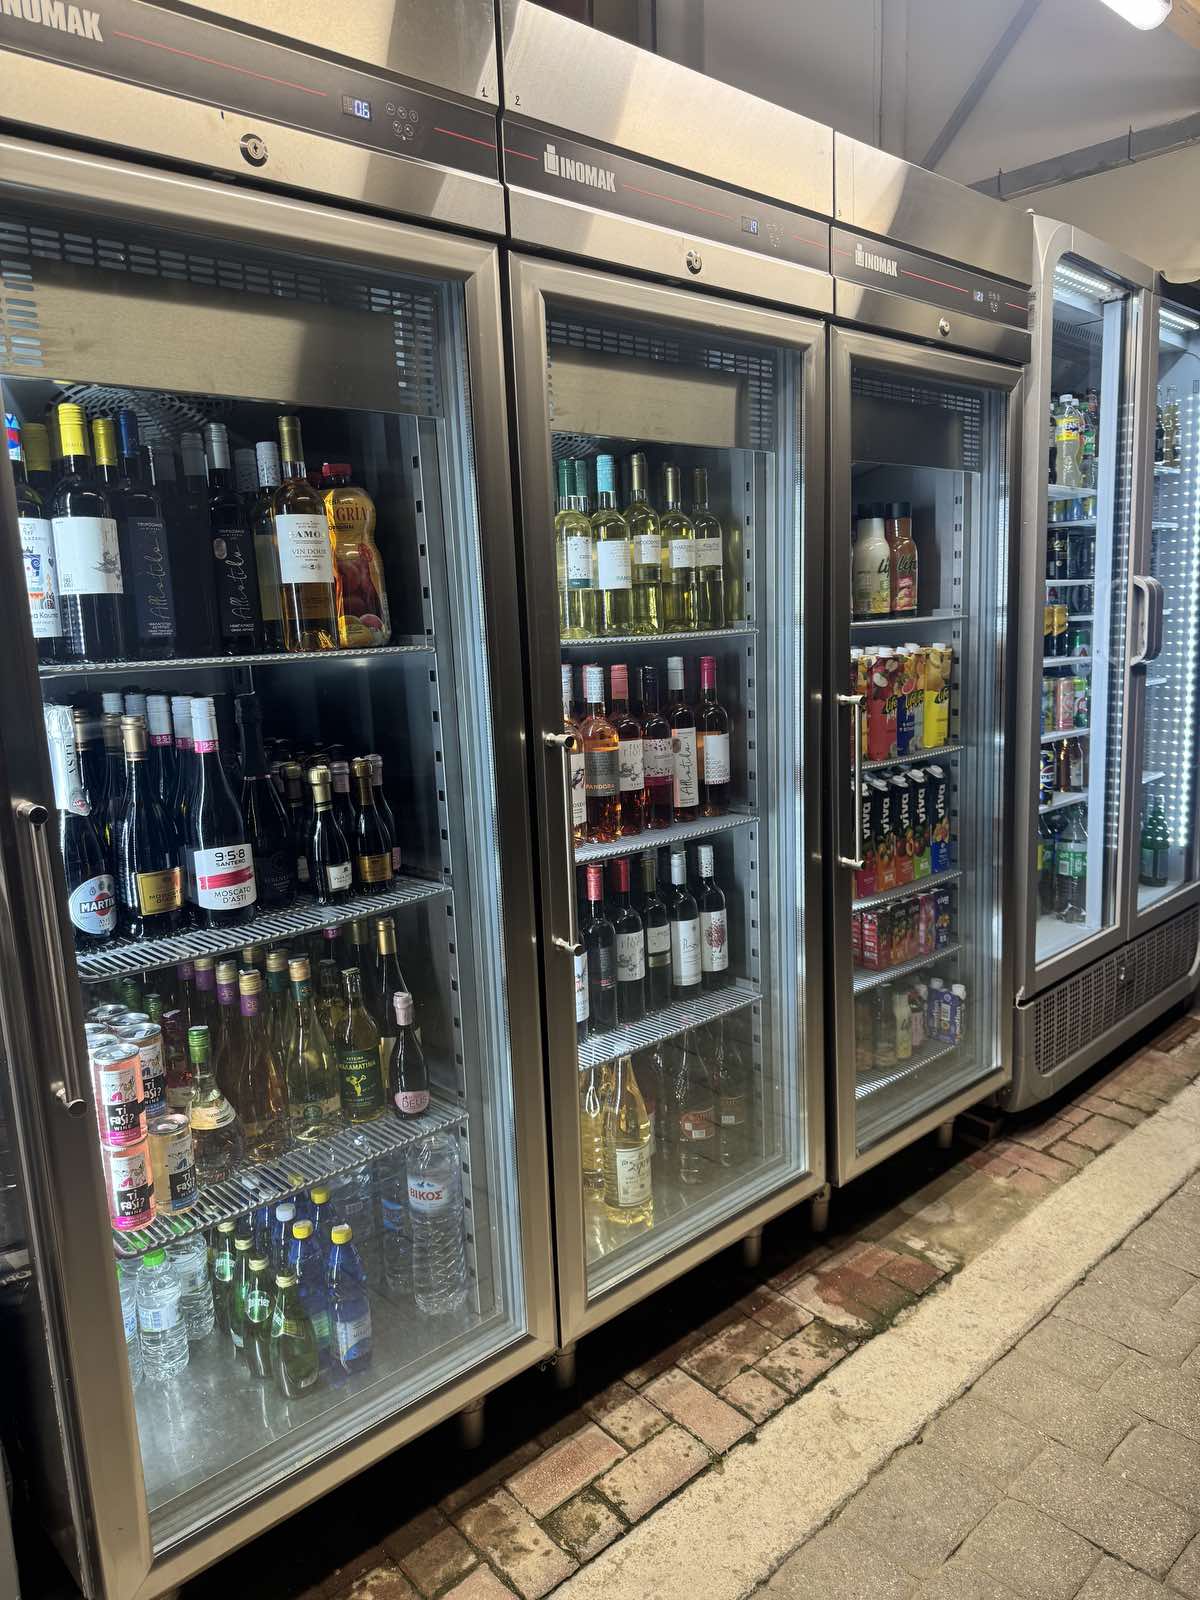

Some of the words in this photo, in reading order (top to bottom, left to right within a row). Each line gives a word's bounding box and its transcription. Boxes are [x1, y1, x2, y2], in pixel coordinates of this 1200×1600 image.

[0, 0, 103, 42] NOMAK
[560, 157, 616, 192] INOMAK
[864, 252, 898, 277] INOMAK
[215, 859, 246, 867] SANTERO
[215, 886, 251, 898] MOSCATO
[222, 894, 247, 904] D'ASTI
[115, 1105, 126, 1115] Ti
[126, 1190, 137, 1200] Ti
